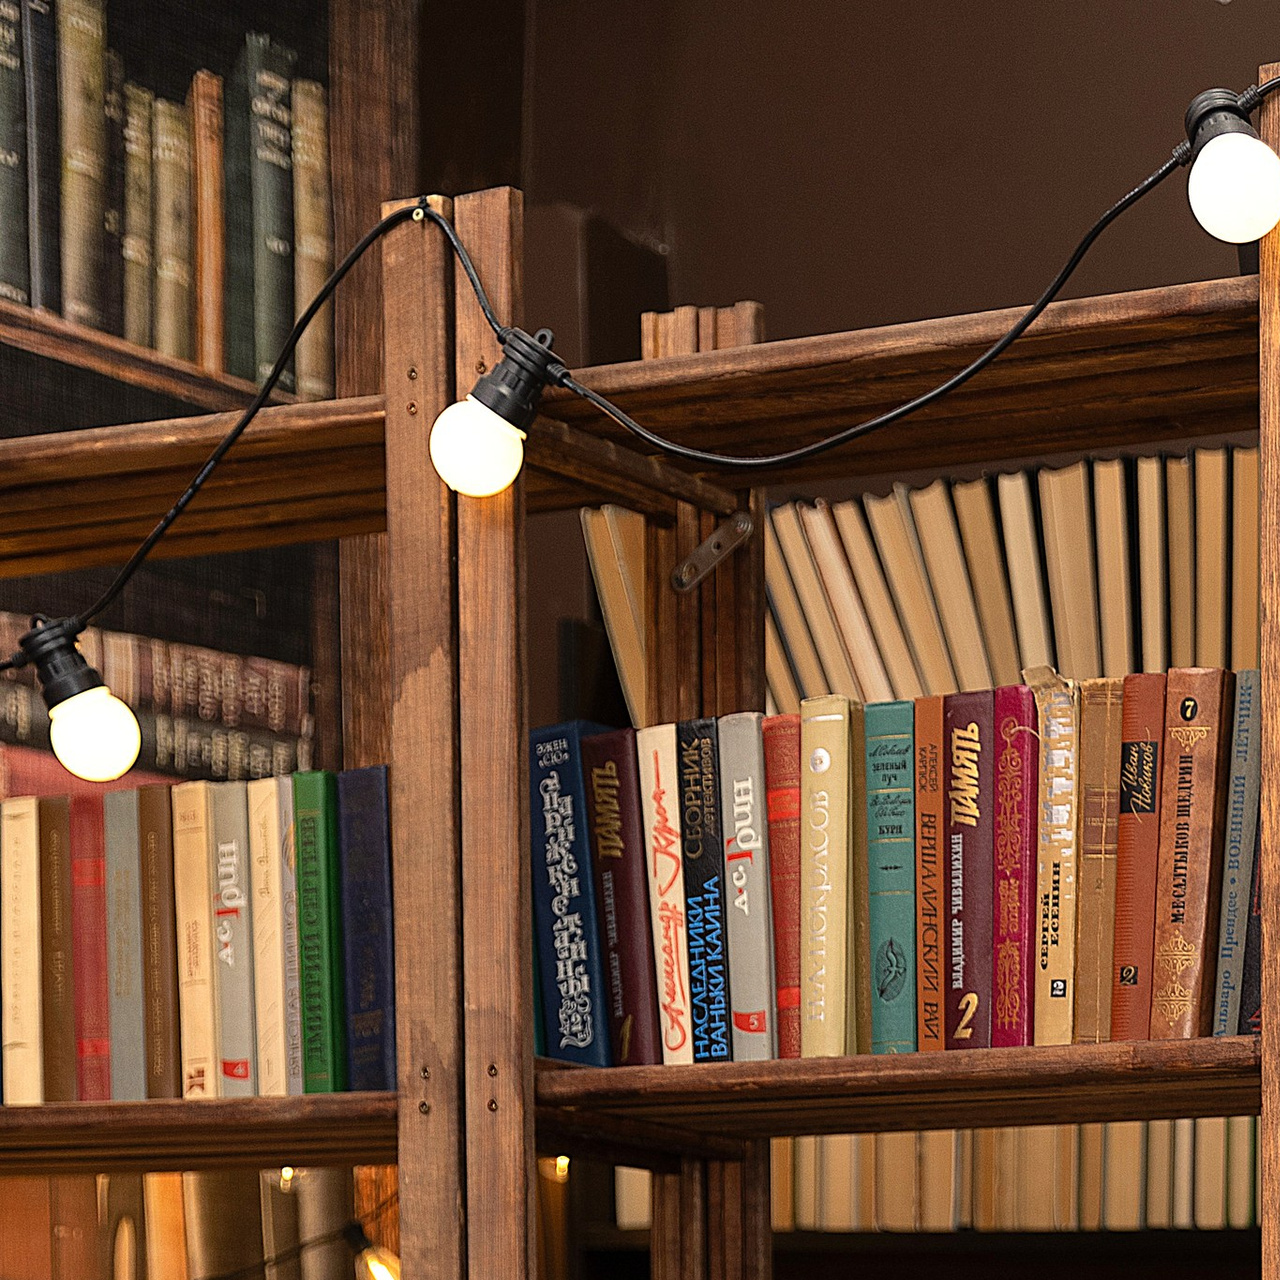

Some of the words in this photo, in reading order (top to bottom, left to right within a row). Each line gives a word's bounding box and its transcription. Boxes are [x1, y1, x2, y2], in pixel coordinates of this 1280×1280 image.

[535, 738, 568, 756] ЭЖЕН
[1184, 700, 1196, 718] 7
[541, 750, 565, 768] СЮ
[681, 737, 703, 860] СБОРНИК
[918, 746, 929, 793] КАРПЮК
[928, 743, 939, 793] АЛЕКСЕЙ
[949, 721, 982, 828] ПАМЯТЬ
[1121, 744, 1140, 792] Иван
[1130, 733, 1154, 823] Новиков
[1176, 754, 1194, 819] ЩЕДРИН
[591, 760, 625, 860] ПАМЯТЬ
[725, 776, 763, 872] Грин
[878, 825, 903, 836] БУРЯ
[213, 839, 246, 920] Грин
[300, 815, 320, 927] СЕРГЕЕВ
[920, 812, 940, 993] ВЕРШАЛИНСКИЙ
[950, 833, 964, 916] ЧИВИЛИХИН
[1049, 861, 1061, 947] ЕСЕНИН
[1213, 971, 1237, 1037] Альваро
[1228, 775, 1247, 870] ВОЕННЫЙ
[703, 875, 724, 961] КАИНА
[951, 917, 964, 990] ВЛАДИМИР
[1038, 892, 1050, 971] СЕРГЕЙ
[303, 934, 325, 1065] ДМИТРИЙ
[658, 901, 687, 1051] Александр
[687, 895, 711, 1059] НАСЛЕДНИКИ
[706, 964, 728, 1058] ВАНЬКИ
[952, 992, 980, 1040] 2
[1051, 980, 1065, 996] 2
[1121, 966, 1135, 986] 2
[923, 1001, 940, 1041] РАЙ
